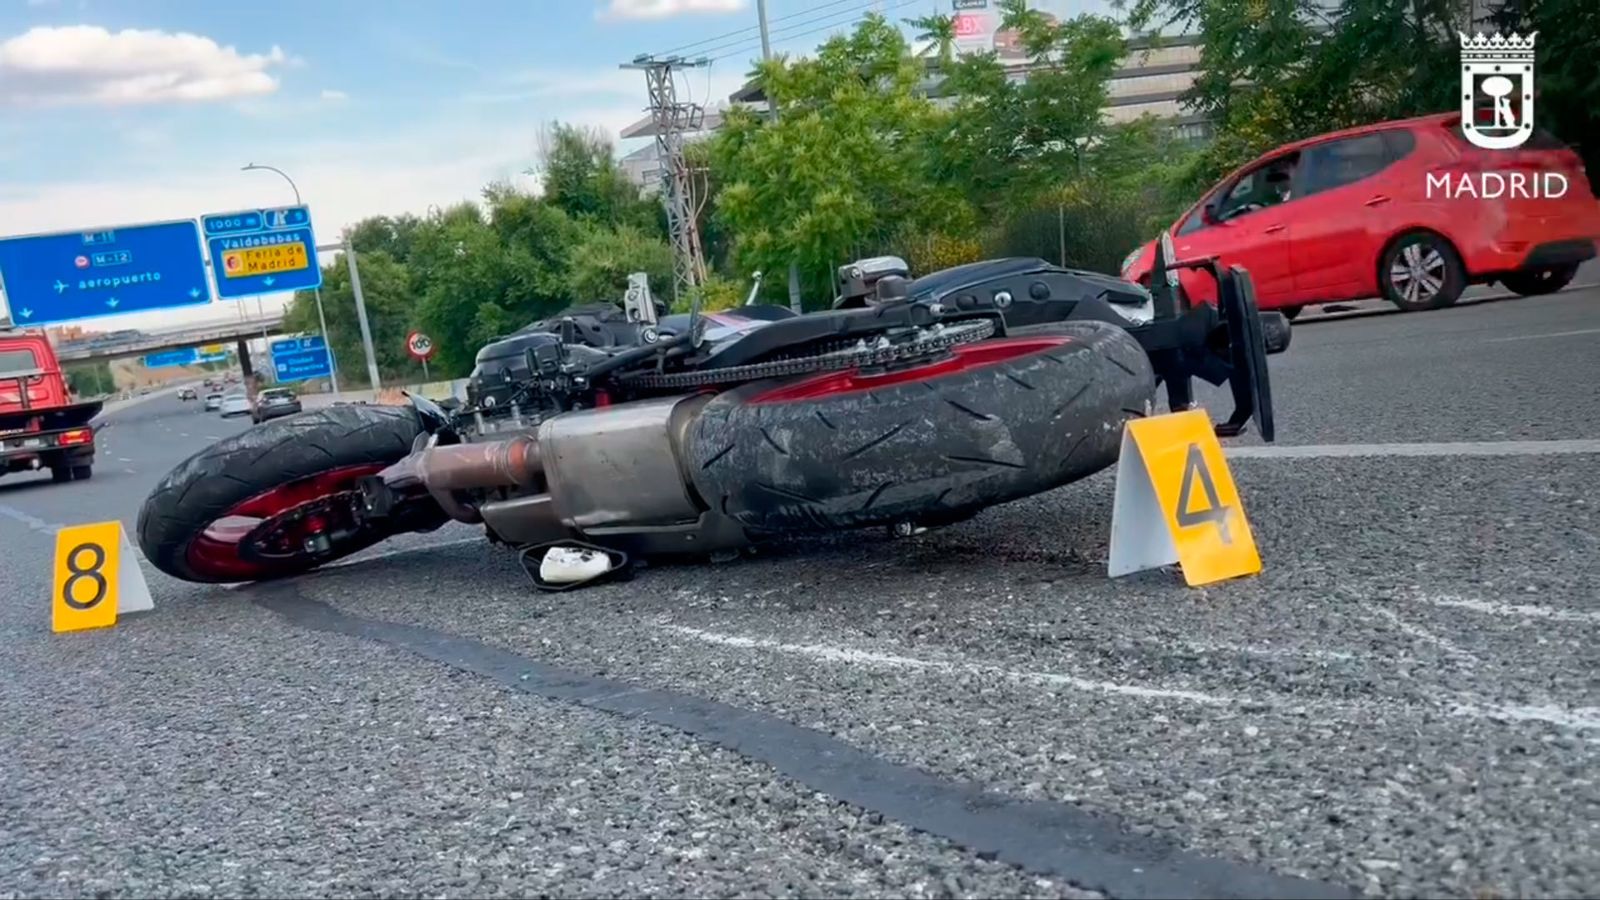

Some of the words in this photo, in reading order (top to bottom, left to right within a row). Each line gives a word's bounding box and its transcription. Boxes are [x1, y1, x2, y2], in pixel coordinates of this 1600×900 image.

[210, 219, 242, 230] 1000
[221, 233, 301, 249] Valdebebas
[95, 252, 129, 264] M-12
[246, 248, 281, 260] Feria
[287, 246, 303, 255] de
[248, 258, 296, 272] Madrid
[78, 271, 161, 289] aeropuerto
[411, 337, 431, 350] 100
[1176, 443, 1233, 545] 4
[62, 542, 107, 610] 8
